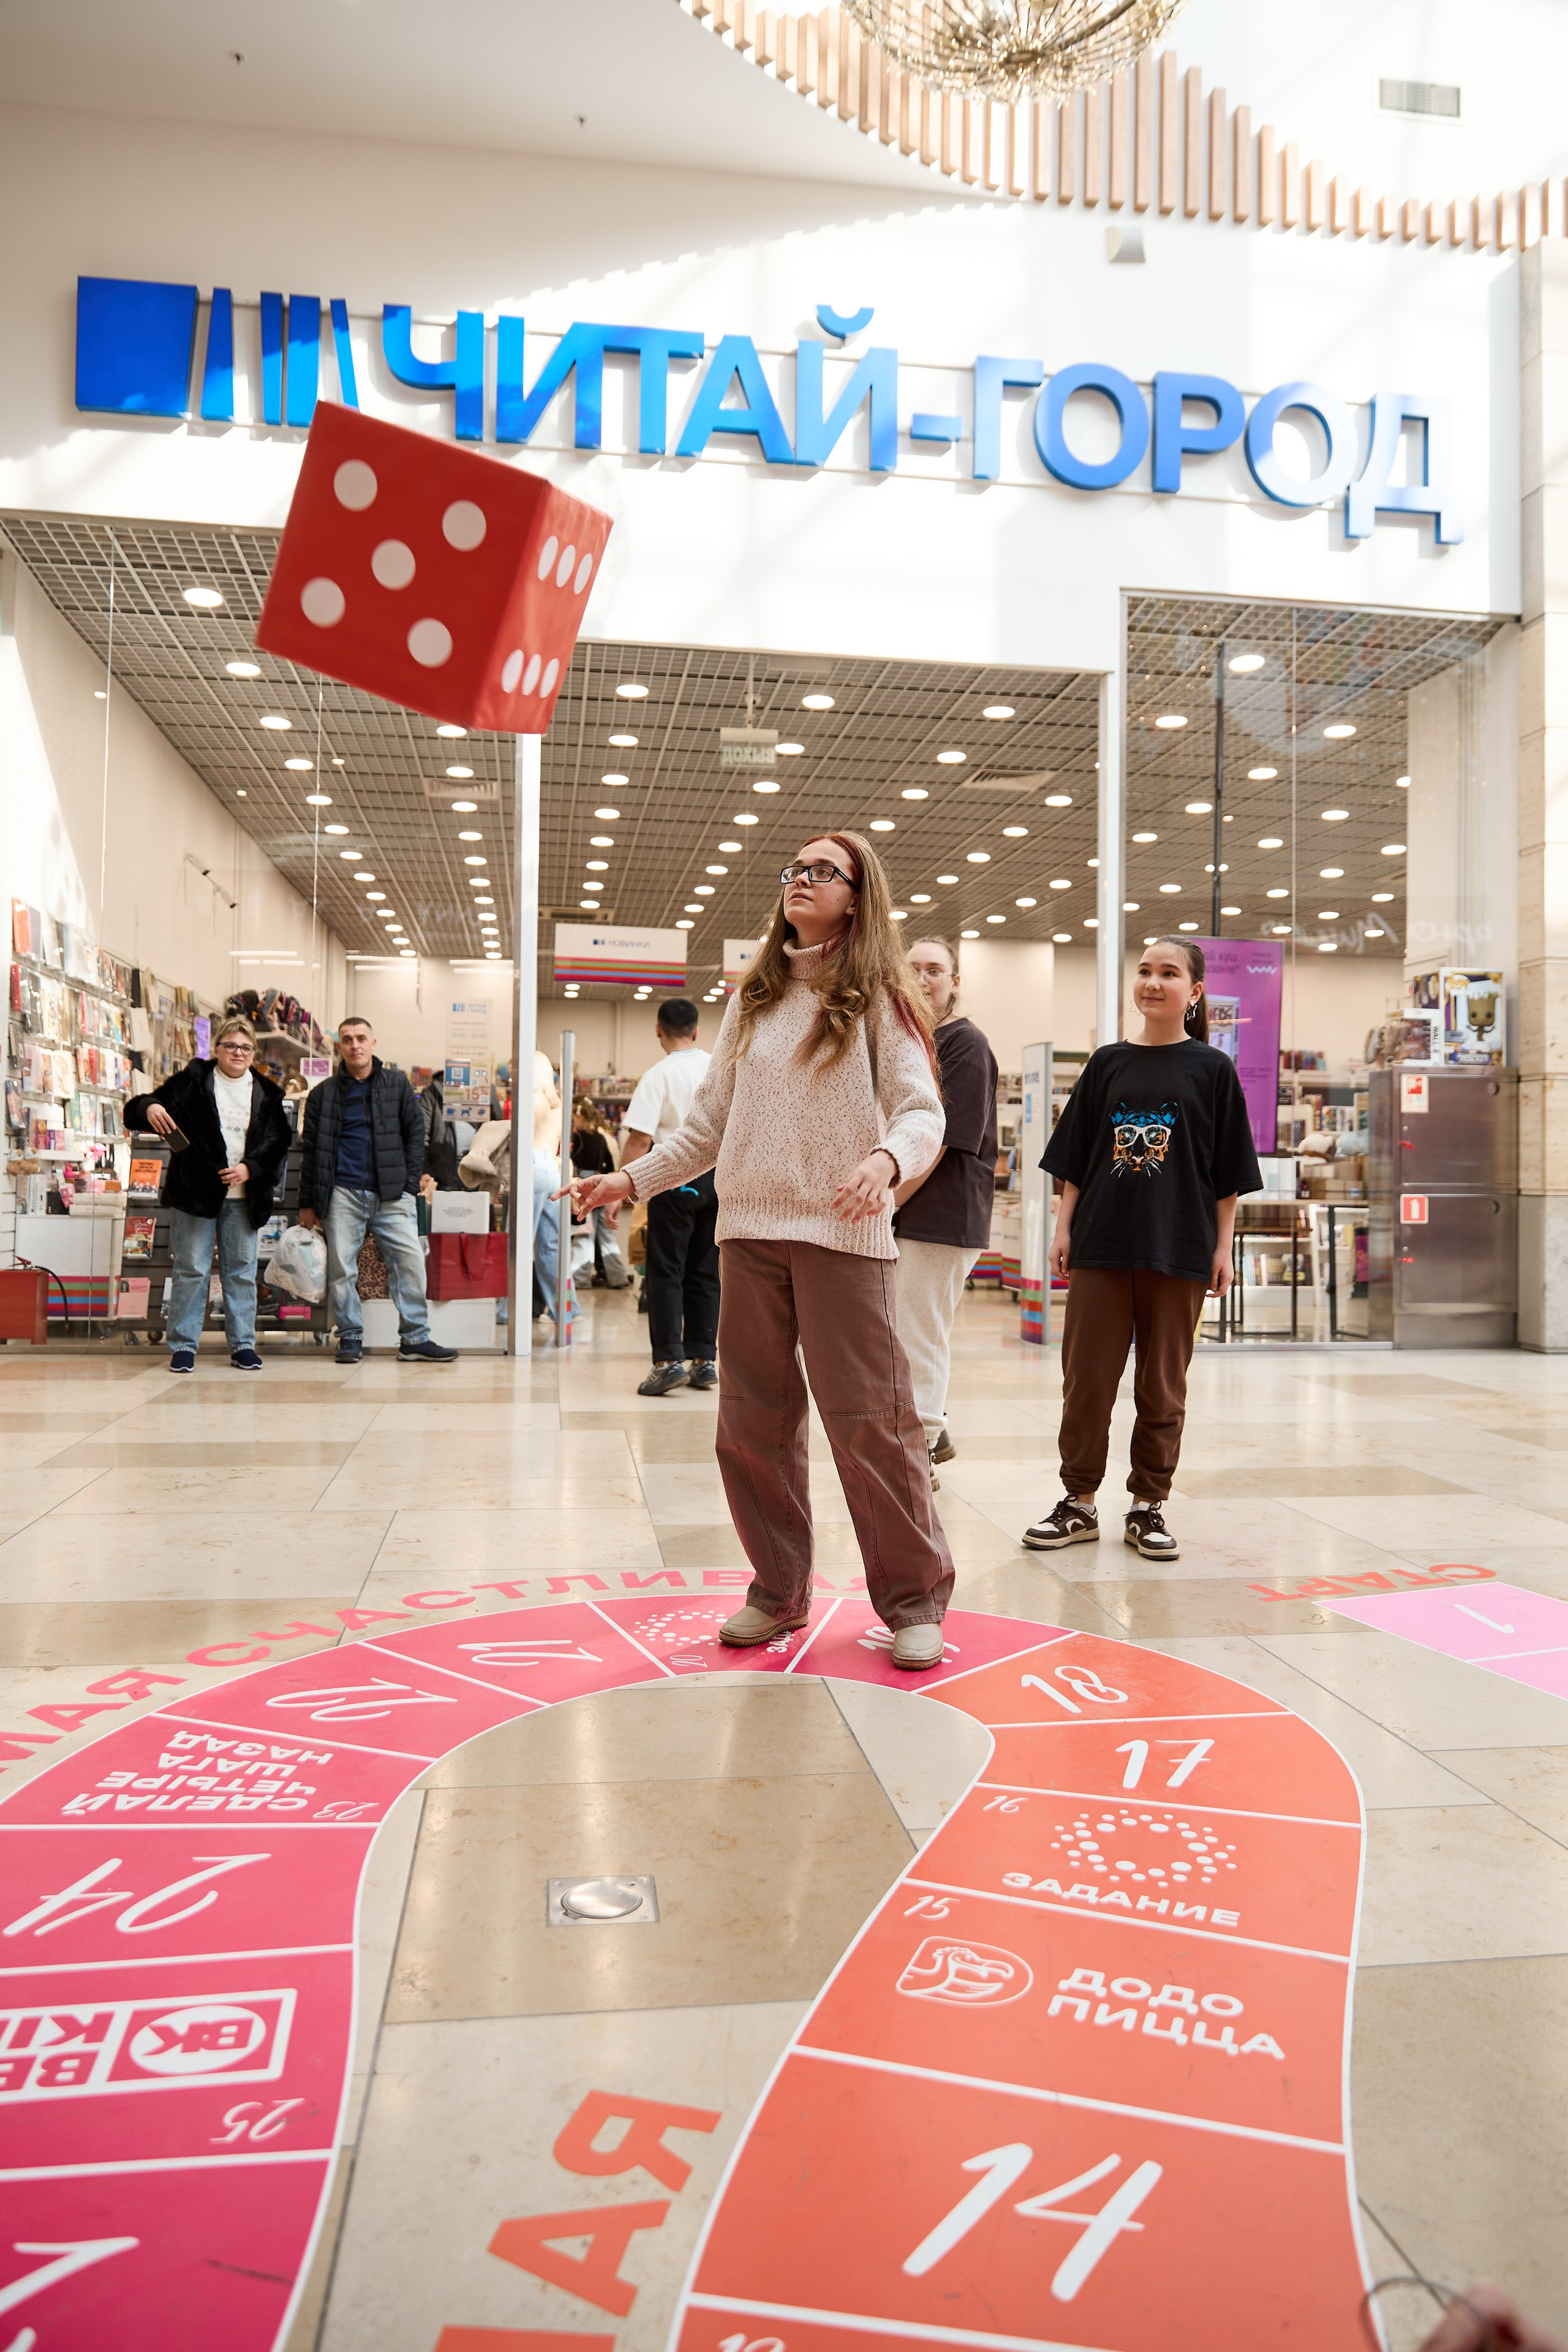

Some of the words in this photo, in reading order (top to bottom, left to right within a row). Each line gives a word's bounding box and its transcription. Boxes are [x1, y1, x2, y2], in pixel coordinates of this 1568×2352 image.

[382, 304, 1465, 546] ЧИТАЙ-ГОРОД
[608, 939, 650, 948] НОВИНКИ
[1246, 1564, 1497, 1602] СТАРТ
[1452, 1604, 1515, 1634] 1
[669, 1654, 709, 1668] 20
[266, 1677, 458, 1722] 22
[1021, 1665, 1129, 1713] 18
[0, 1670, 190, 1774] МАЯ
[157, 1752, 298, 1777] ШАГА
[165, 1730, 334, 1765] НАЗАД
[1115, 1738, 1216, 1789] 17
[61, 1792, 309, 1815] СДЕЛАЙ
[96, 1771, 318, 1796] ЧЕТЫРЕ
[982, 1794, 1029, 1814] 16
[312, 1801, 380, 1820] 23
[2, 1853, 272, 1936] 24
[903, 1894, 960, 1920] 15
[1001, 1872, 1241, 1928] ЗАДАНИЕ
[1058, 1967, 1245, 2018] ДОДО
[1047, 1993, 1285, 2060] ПИЦЦА
[209, 2097, 305, 2144] 25
[432, 2090, 723, 2352] АЯ
[902, 2142, 1164, 2302] 14
